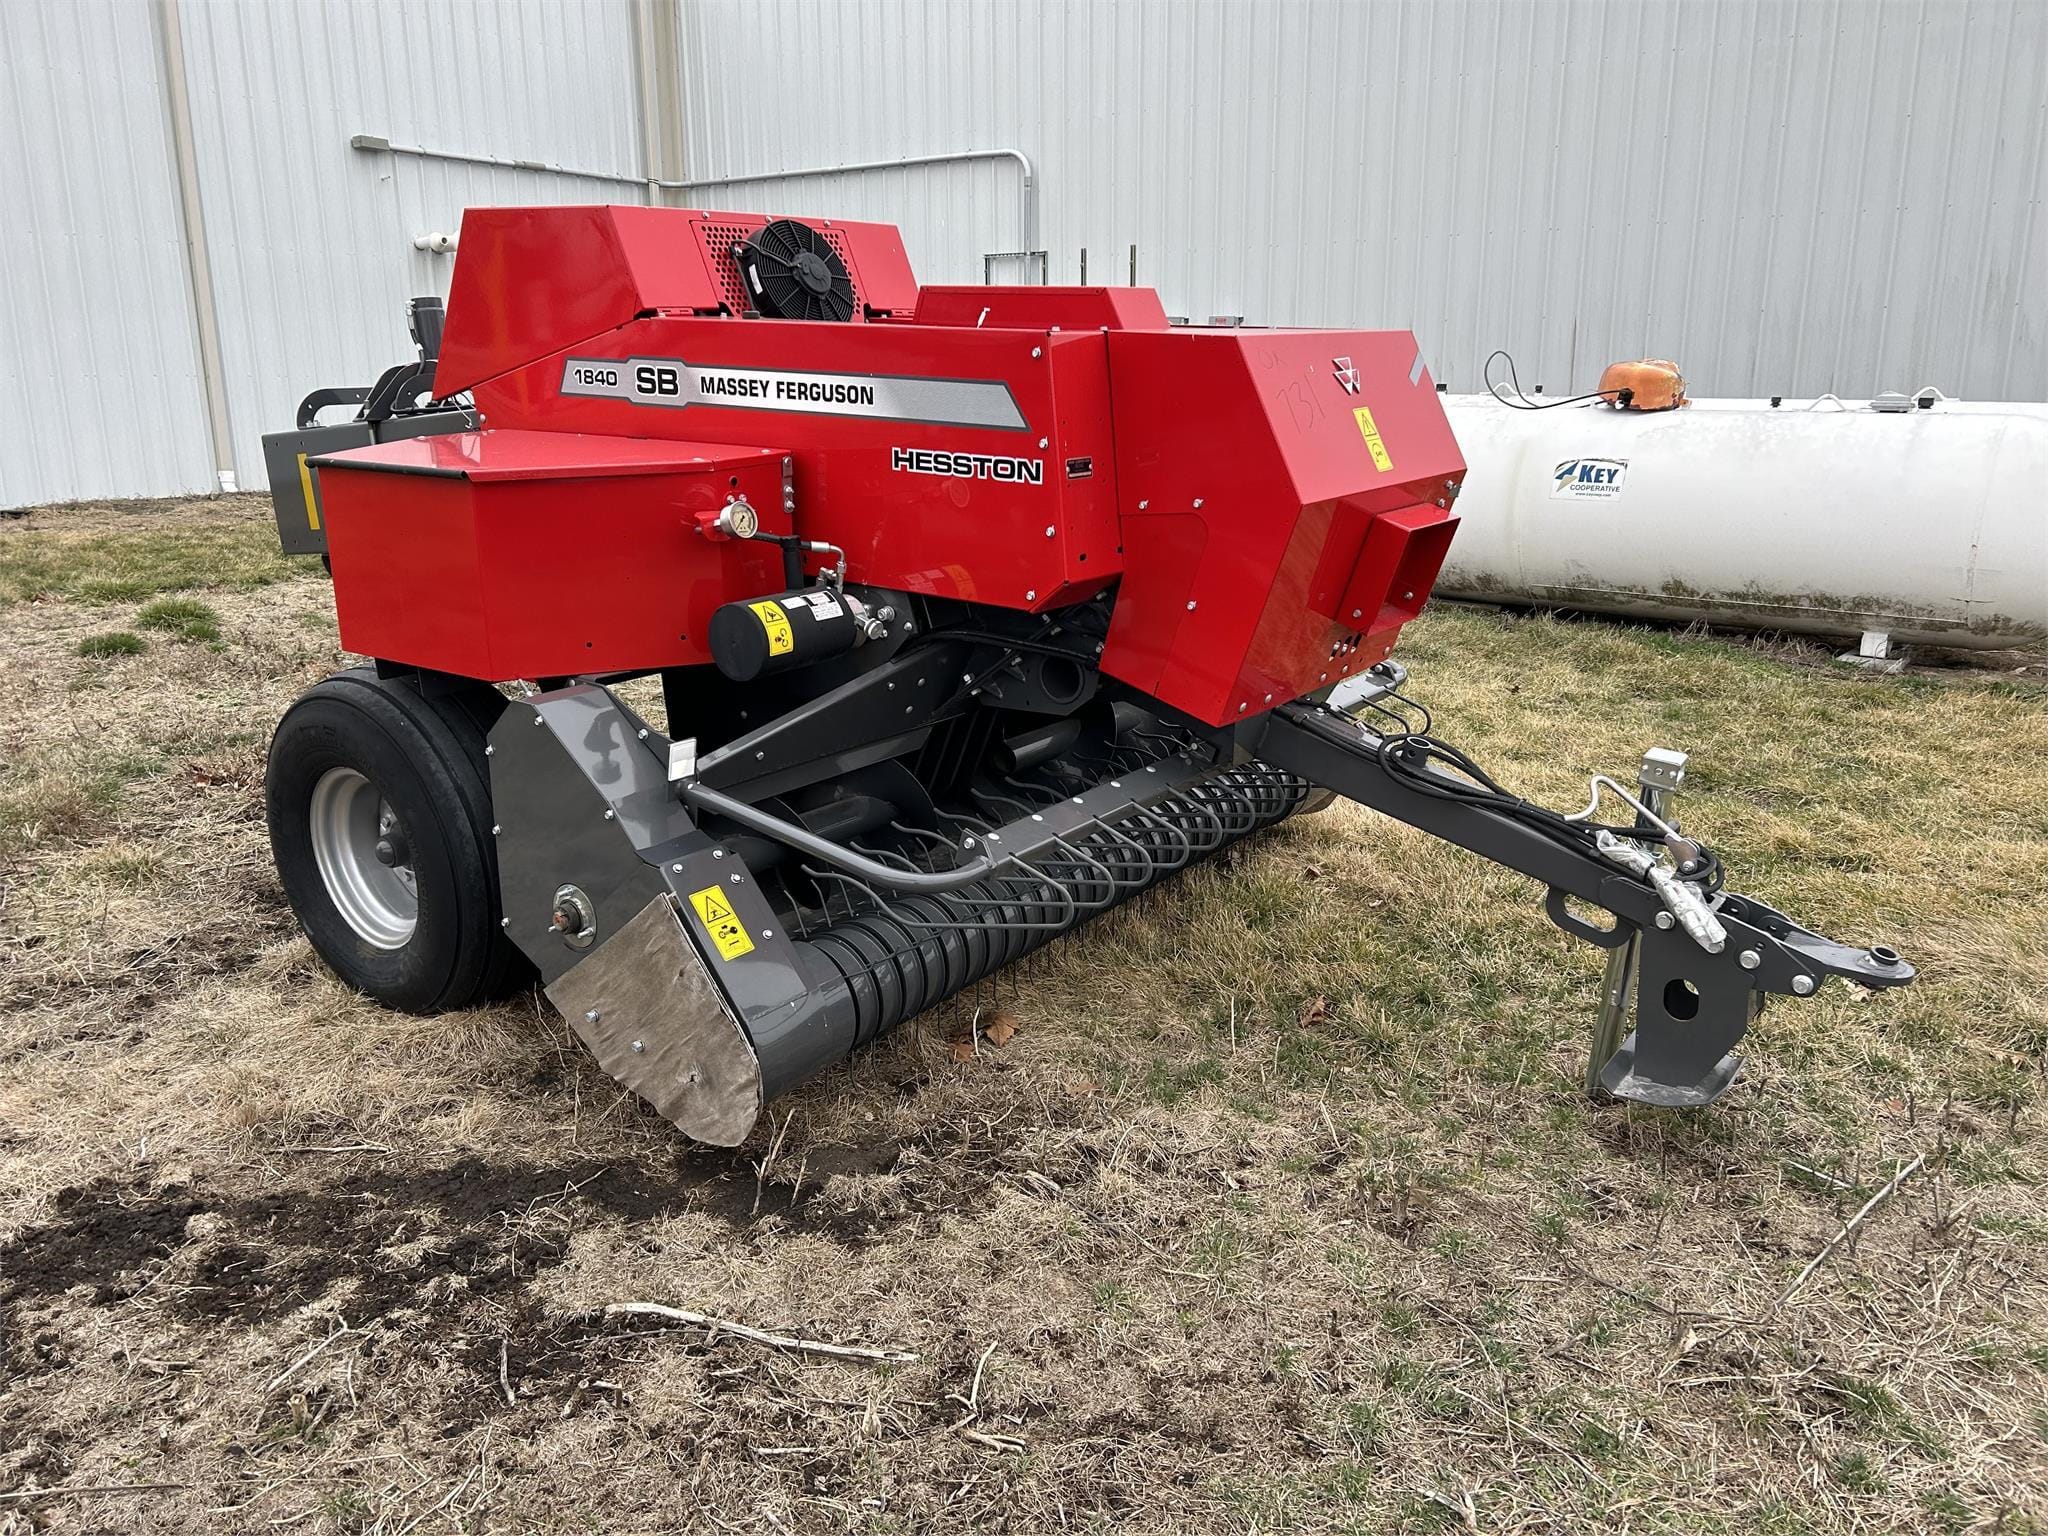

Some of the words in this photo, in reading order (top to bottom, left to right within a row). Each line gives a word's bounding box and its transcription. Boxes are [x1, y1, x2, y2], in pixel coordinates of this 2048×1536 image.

[574, 367, 618, 387] 1840
[636, 367, 679, 396] SB
[701, 376, 769, 398] MASSEY
[776, 382, 875, 406] FERGUSON
[892, 448, 1043, 484] HESSTON
[1570, 484, 1620, 493] COOPERATIVE
